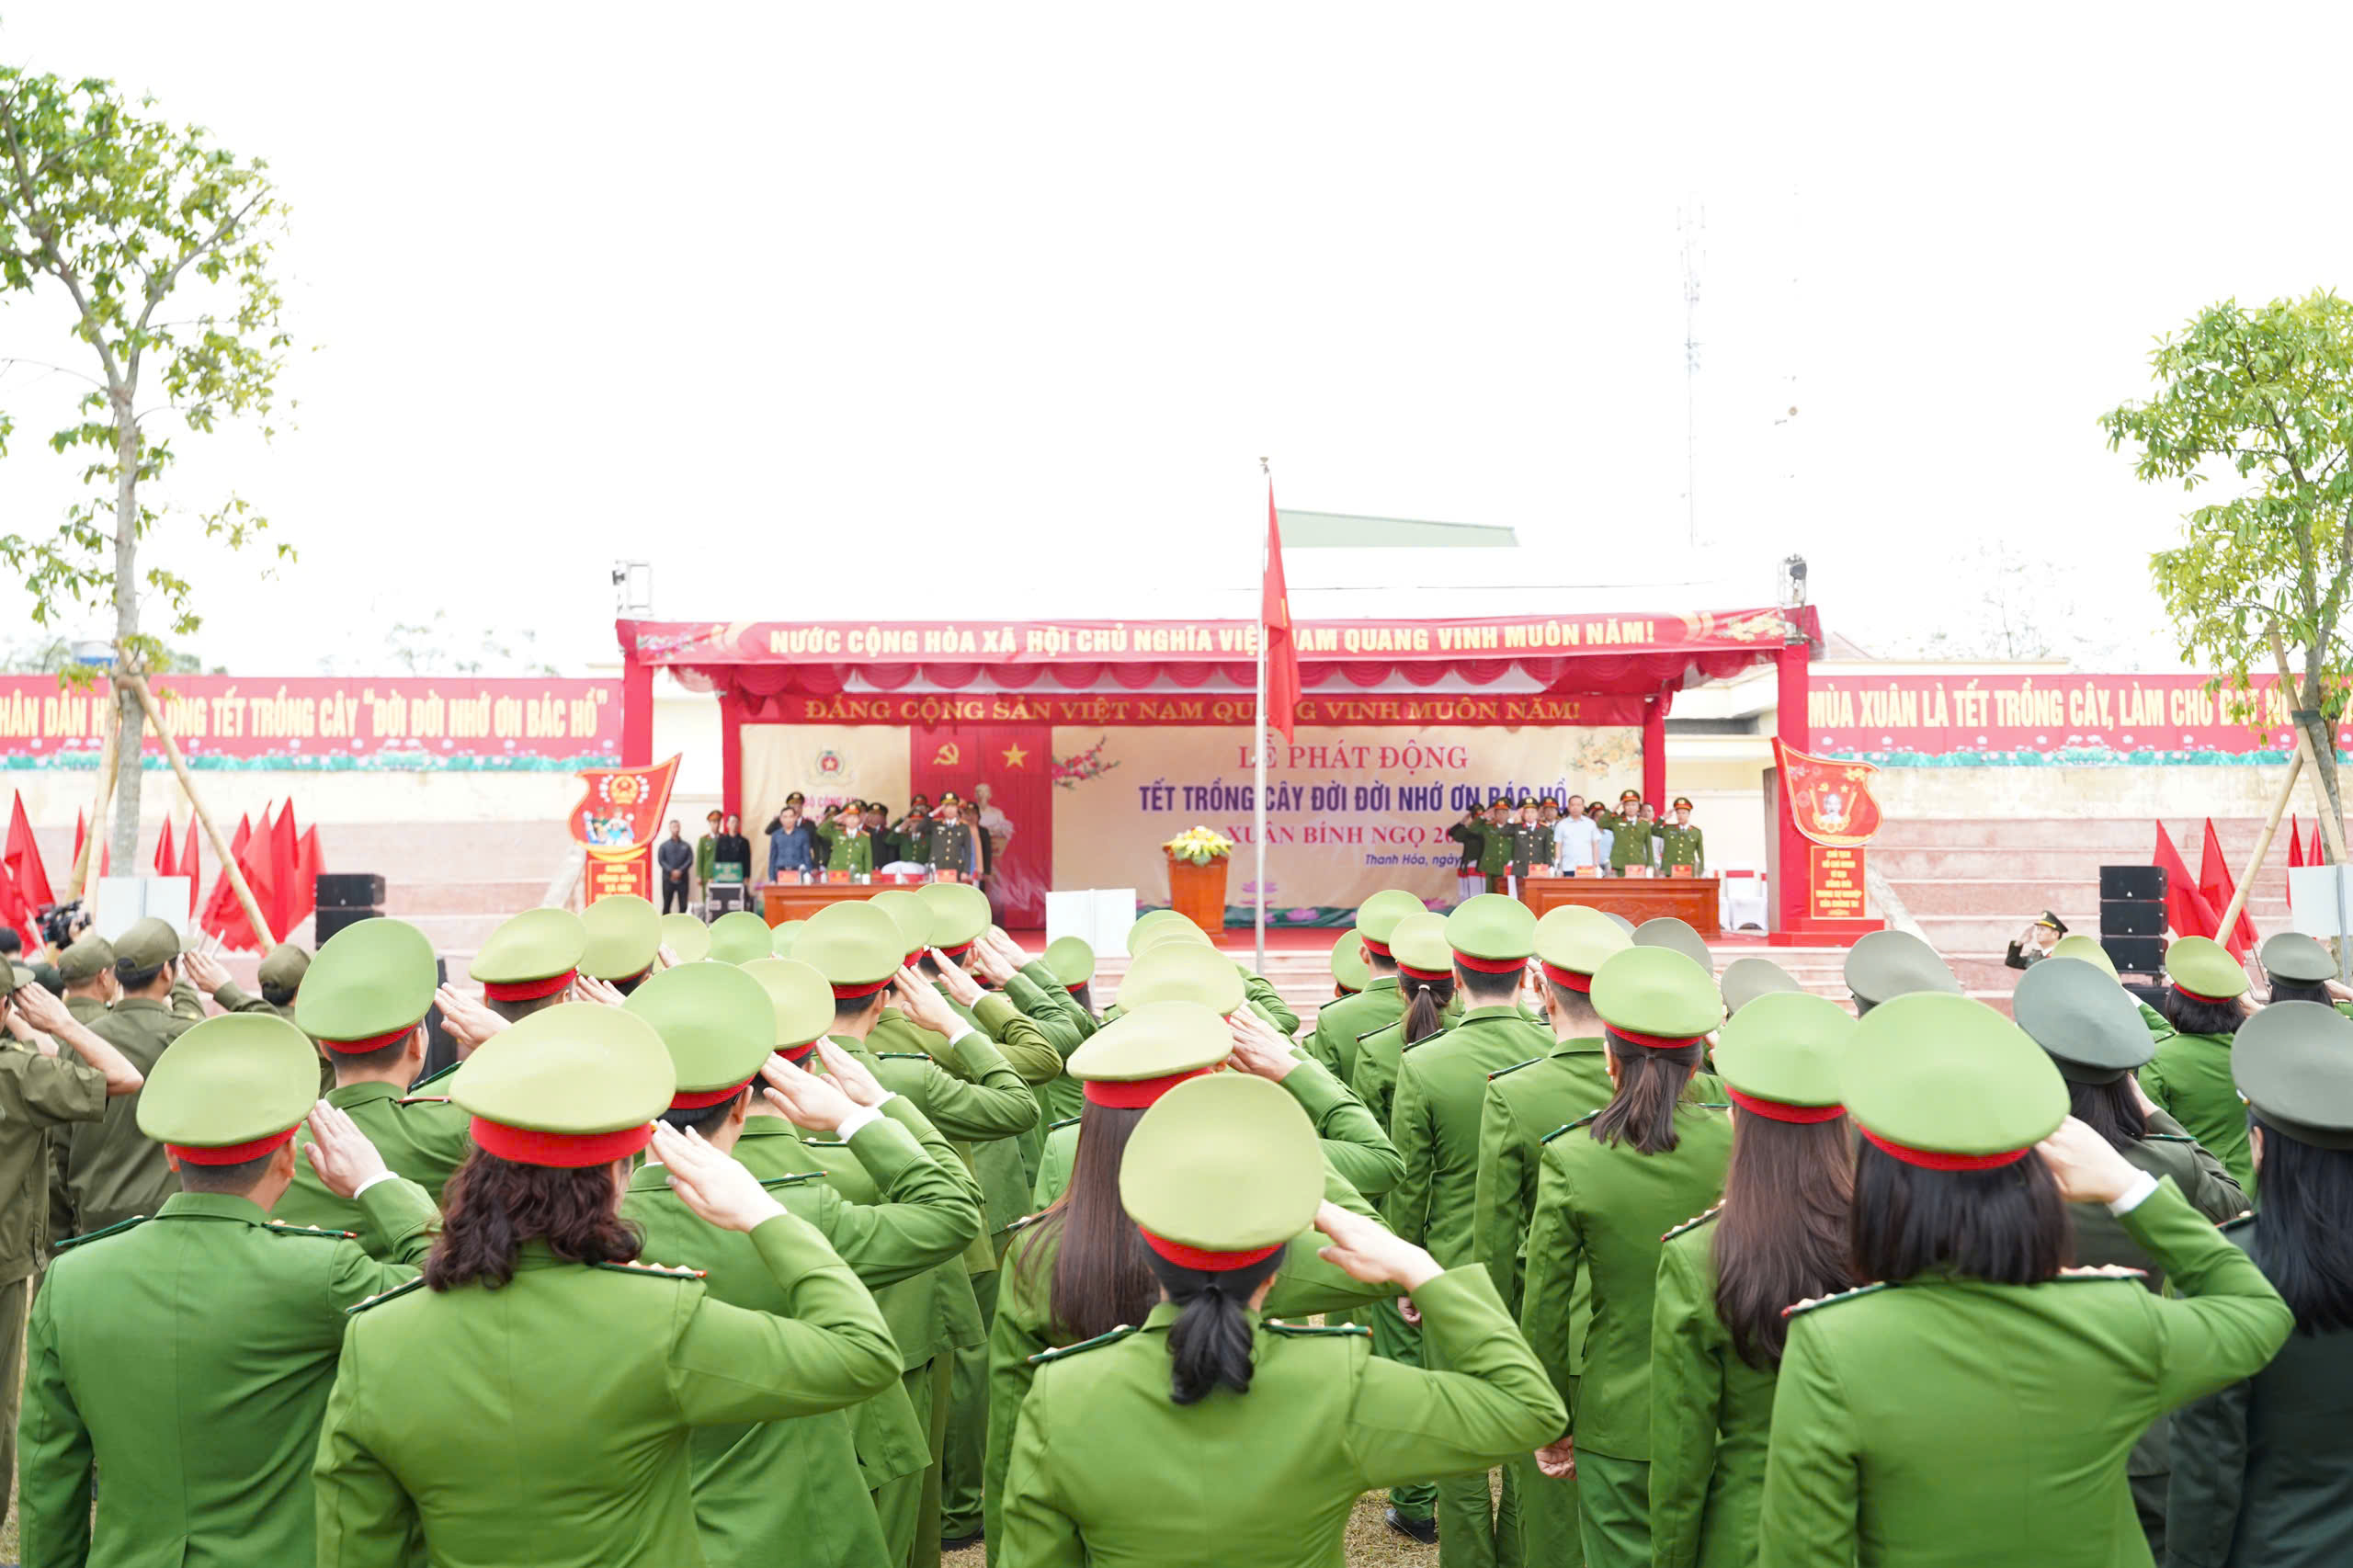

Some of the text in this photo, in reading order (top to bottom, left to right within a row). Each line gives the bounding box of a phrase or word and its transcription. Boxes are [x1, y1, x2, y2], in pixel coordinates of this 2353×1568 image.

[770, 618, 1654, 657] NƯỚC CỘNG HÒA XÃ HỘI CHỦ NGHĨA VIỆ AM QUANG VINH MUÔN NĂM!
[44, 688, 86, 737] DÂN
[211, 686, 246, 737] TẾT
[319, 689, 358, 737] CÂY
[411, 688, 445, 737] ĐỜI
[449, 691, 491, 737] NHỚ
[494, 695, 523, 737] ƠN
[527, 691, 566, 737] BÁC
[805, 694, 1581, 724] ĐẢNG CỘNG SẢN VIỆT NAM QUG VINH MUÔN NĂM!
[1808, 683, 1855, 728] MÙA
[1859, 683, 1917, 728] XUÂN
[1922, 682, 1949, 728] LÀ
[1953, 678, 1989, 728] TẾT
[1994, 677, 2064, 728] TRỒNG
[2069, 681, 2114, 732] CÂY,
[2119, 681, 2165, 727] LÀM
[2170, 688, 2214, 727] CHO
[1287, 739, 1370, 768] PHÁT
[1379, 739, 1468, 775] ĐỘNG
[1139, 778, 1176, 811] TẾT
[1183, 778, 1254, 811] TRỒNG
[1266, 780, 1303, 811] CÂY
[1312, 780, 1347, 811] ĐỜI
[1355, 780, 1390, 811] ĐỜI
[1399, 781, 1443, 811] NHỚ
[1450, 784, 1480, 811] ƠN
[1303, 822, 1362, 844] BÍNH
[1371, 826, 1426, 848] NGỌ
[1366, 854, 1399, 865] Thanh
